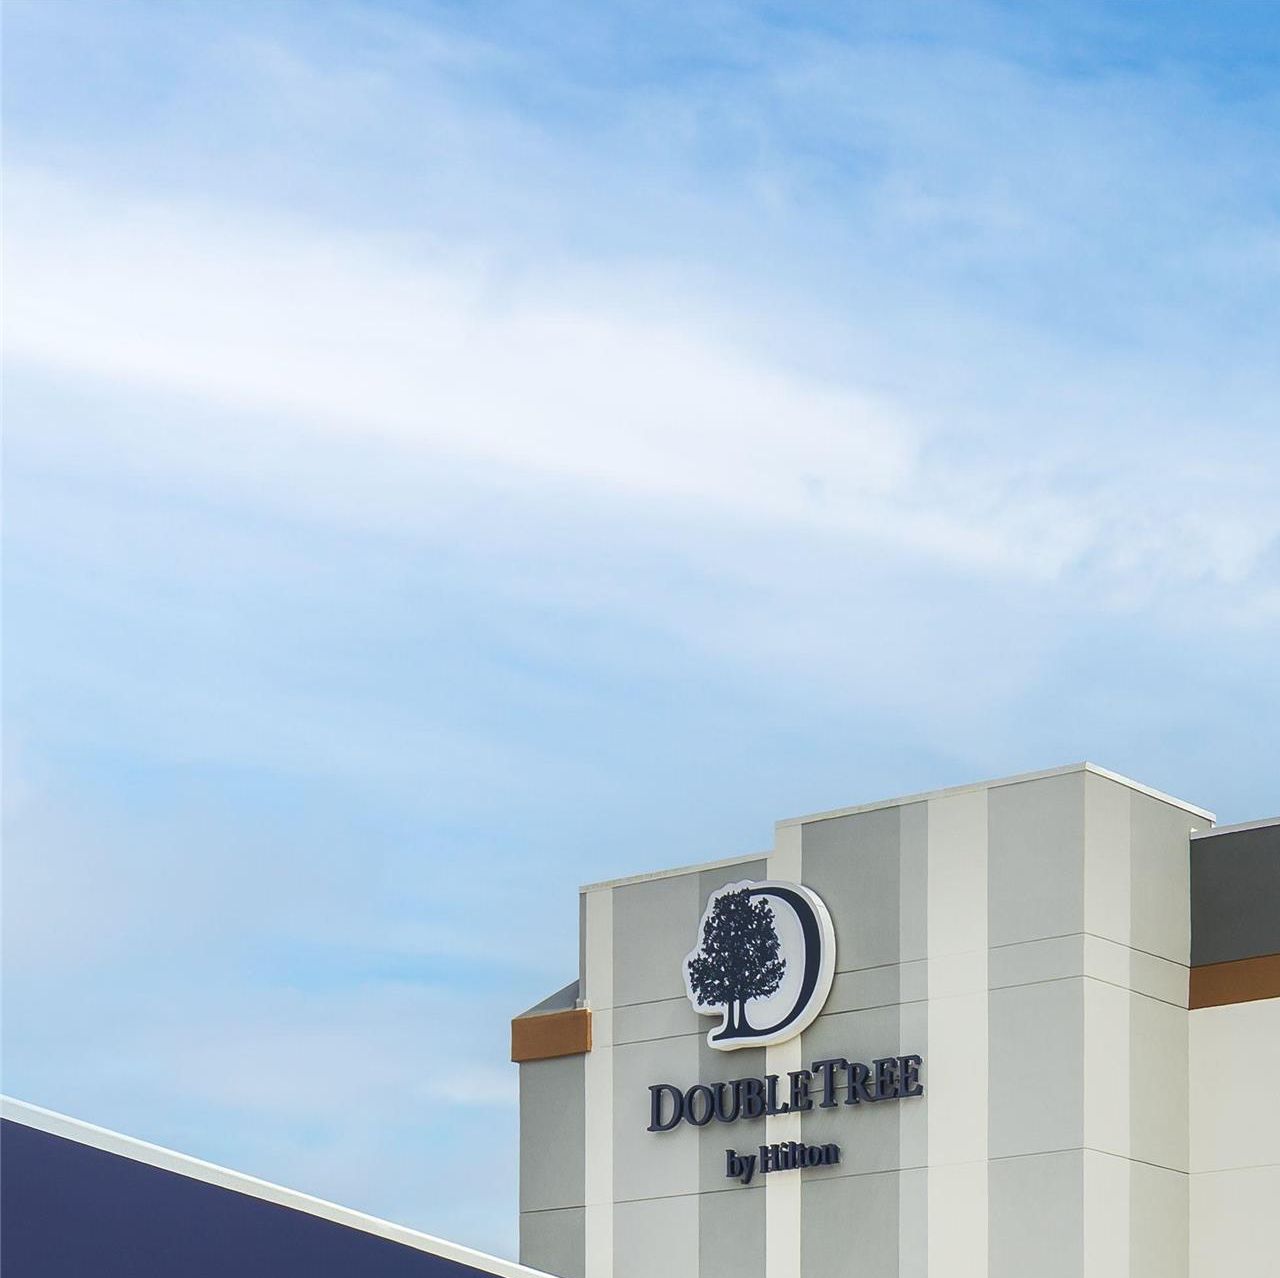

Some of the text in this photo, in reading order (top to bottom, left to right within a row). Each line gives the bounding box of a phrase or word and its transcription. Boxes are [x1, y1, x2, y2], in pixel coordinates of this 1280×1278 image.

[646, 1054, 924, 1133] DOUBLETREE
[725, 1141, 841, 1185] by Hilton
